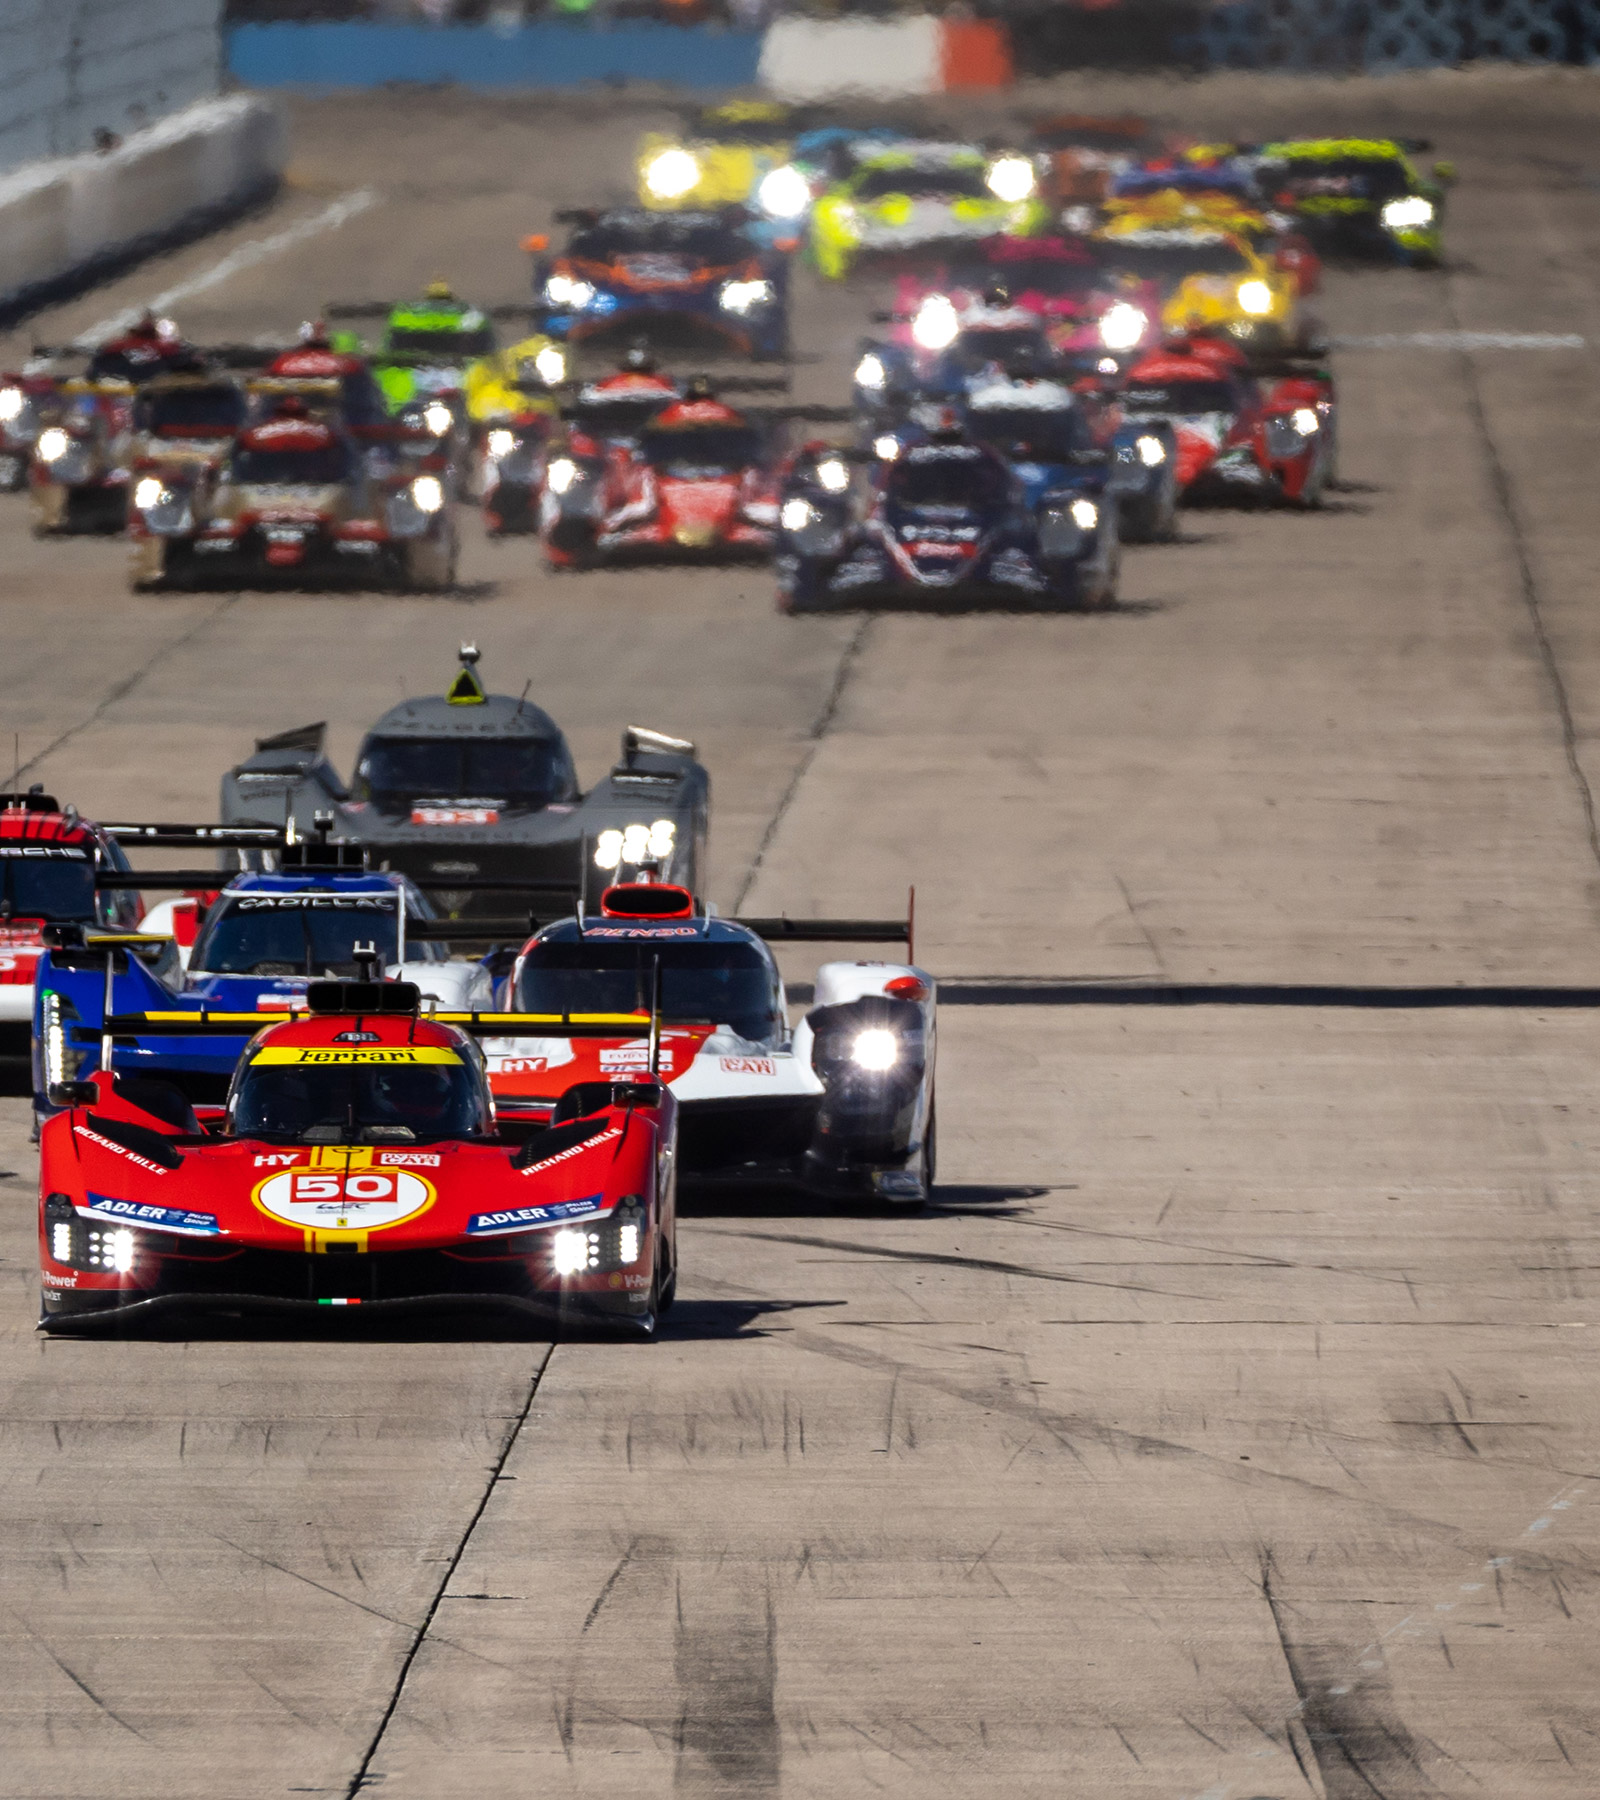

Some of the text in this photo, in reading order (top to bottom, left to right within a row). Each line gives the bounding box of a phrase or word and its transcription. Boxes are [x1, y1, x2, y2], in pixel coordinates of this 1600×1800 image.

[238, 898, 395, 910] CADILLAC
[583, 927, 697, 937] DENSO
[296, 1049, 418, 1062] Ferrari
[504, 1059, 544, 1072] HY
[73, 1125, 168, 1175] RICHARD MILLE
[521, 1127, 624, 1176] RICHARD MILLE
[254, 1153, 299, 1167] HY
[296, 1175, 393, 1199] 50
[92, 1200, 167, 1220] ADLER
[477, 1208, 549, 1227] ADLER
